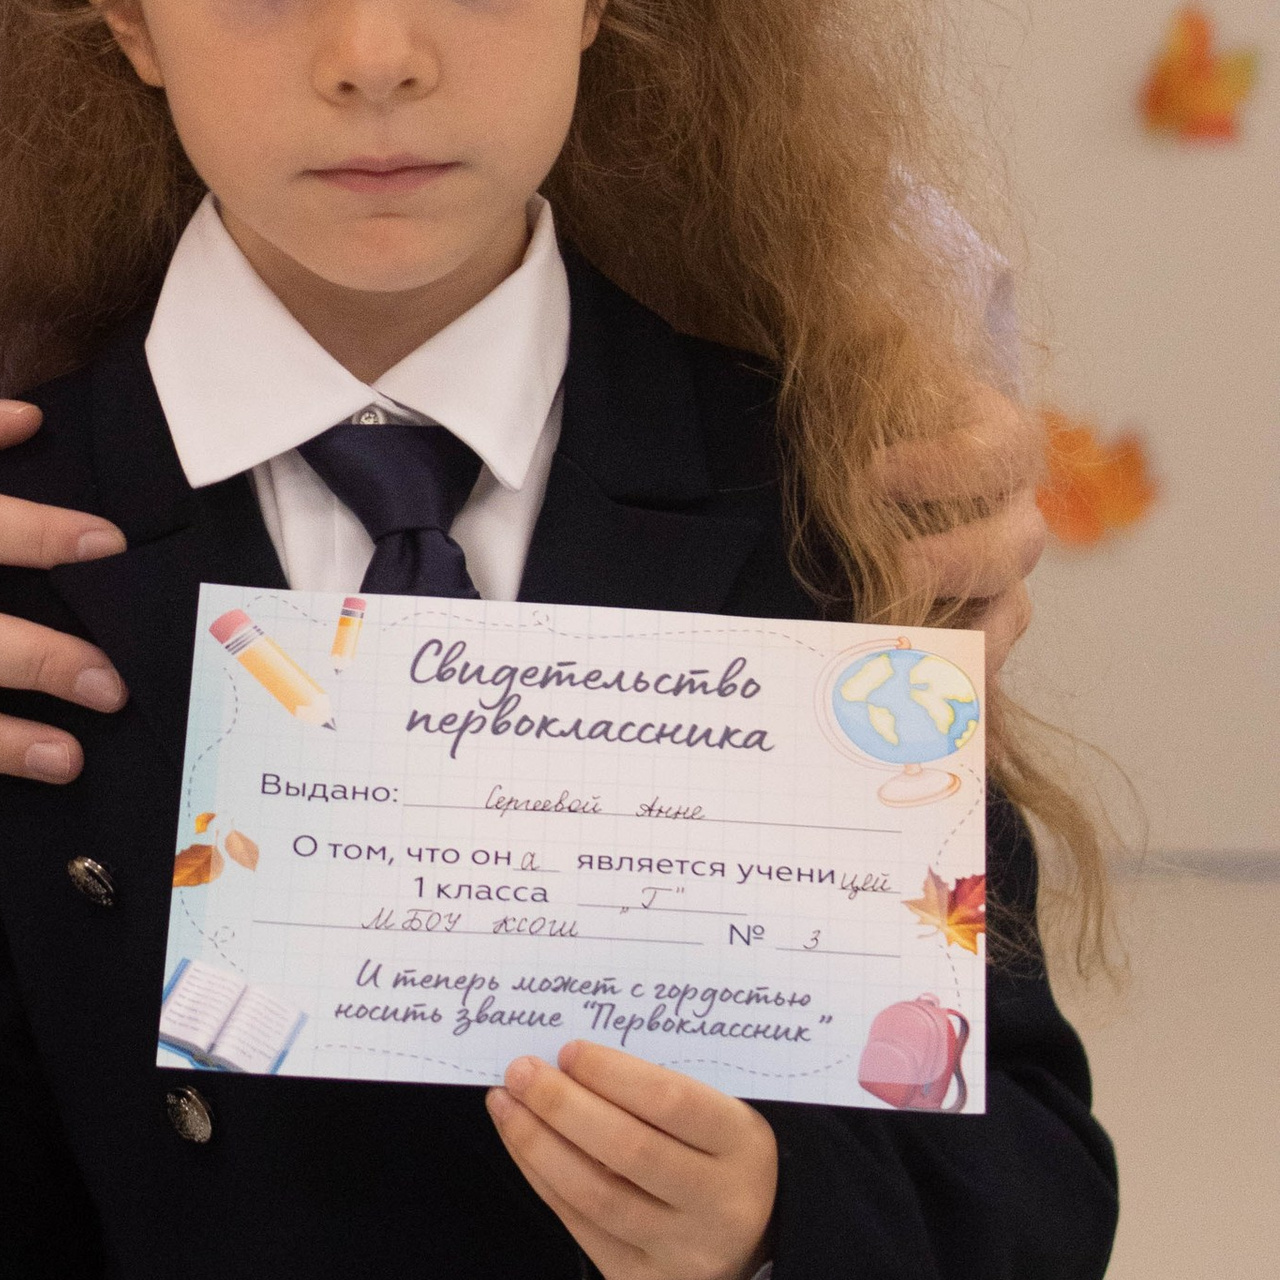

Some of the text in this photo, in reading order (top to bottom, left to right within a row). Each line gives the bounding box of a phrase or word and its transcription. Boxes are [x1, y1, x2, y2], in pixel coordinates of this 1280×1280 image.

[409, 638, 761, 710] Свидетельство
[405, 694, 775, 759] первоклассника
[261, 773, 706, 820] Выдано: Сергеевой Анне
[293, 835, 318, 857] О
[328, 842, 395, 866] том,
[407, 847, 460, 865] что
[577, 853, 726, 877] является
[413, 877, 424, 898] 1
[436, 882, 550, 903] класса
[728, 924, 765, 946] №
[803, 930, 821, 949] 3
[356, 959, 812, 1018] И теперь может с гордостью
[334, 1003, 443, 1023] носить
[453, 995, 564, 1036] звание
